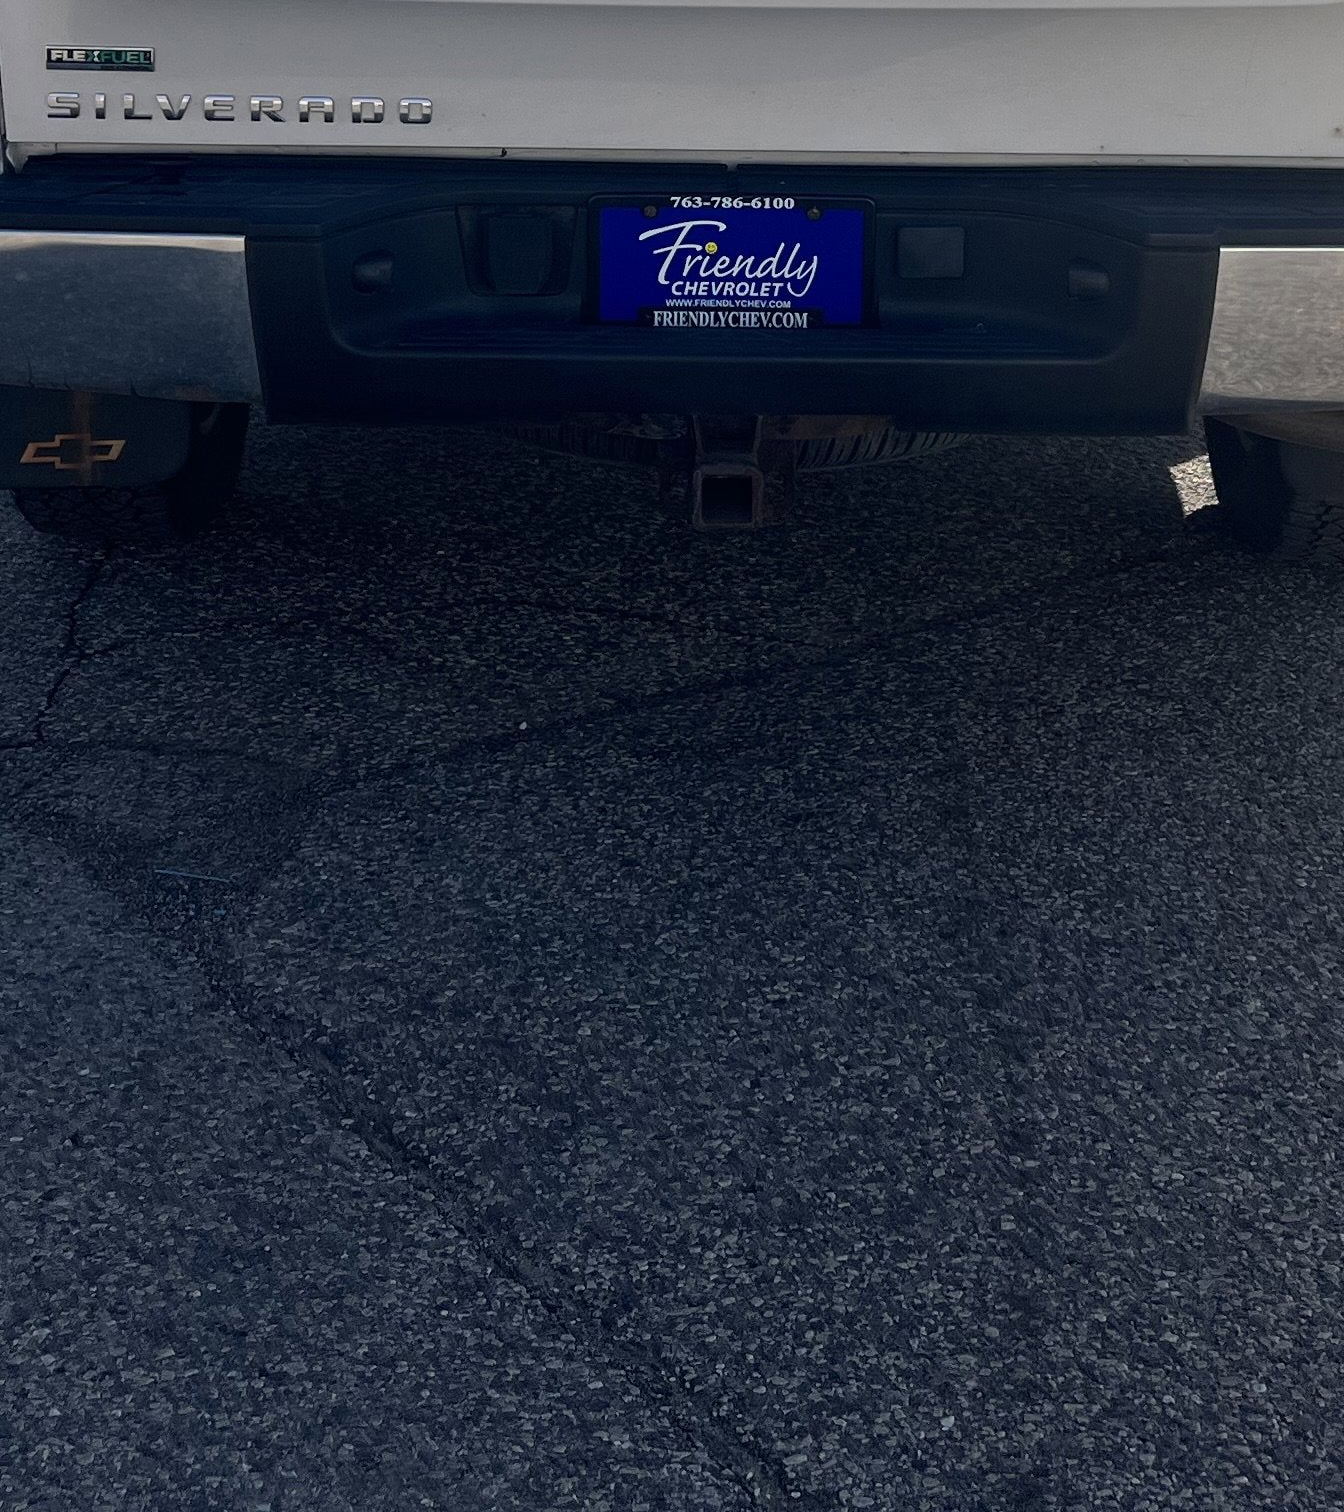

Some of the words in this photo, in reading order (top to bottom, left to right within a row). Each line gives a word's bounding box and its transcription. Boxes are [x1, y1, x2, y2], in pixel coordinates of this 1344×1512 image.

[47, 92, 434, 124] SILVERADO
[669, 196, 795, 210] 763-786-6100
[638, 219, 818, 298] Friendly
[670, 280, 785, 297] CHEVROLET
[665, 297, 792, 309] WWW.FRIENDLYCHEV.COM
[652, 309, 809, 329] FRIENDLYCHEV.COM
